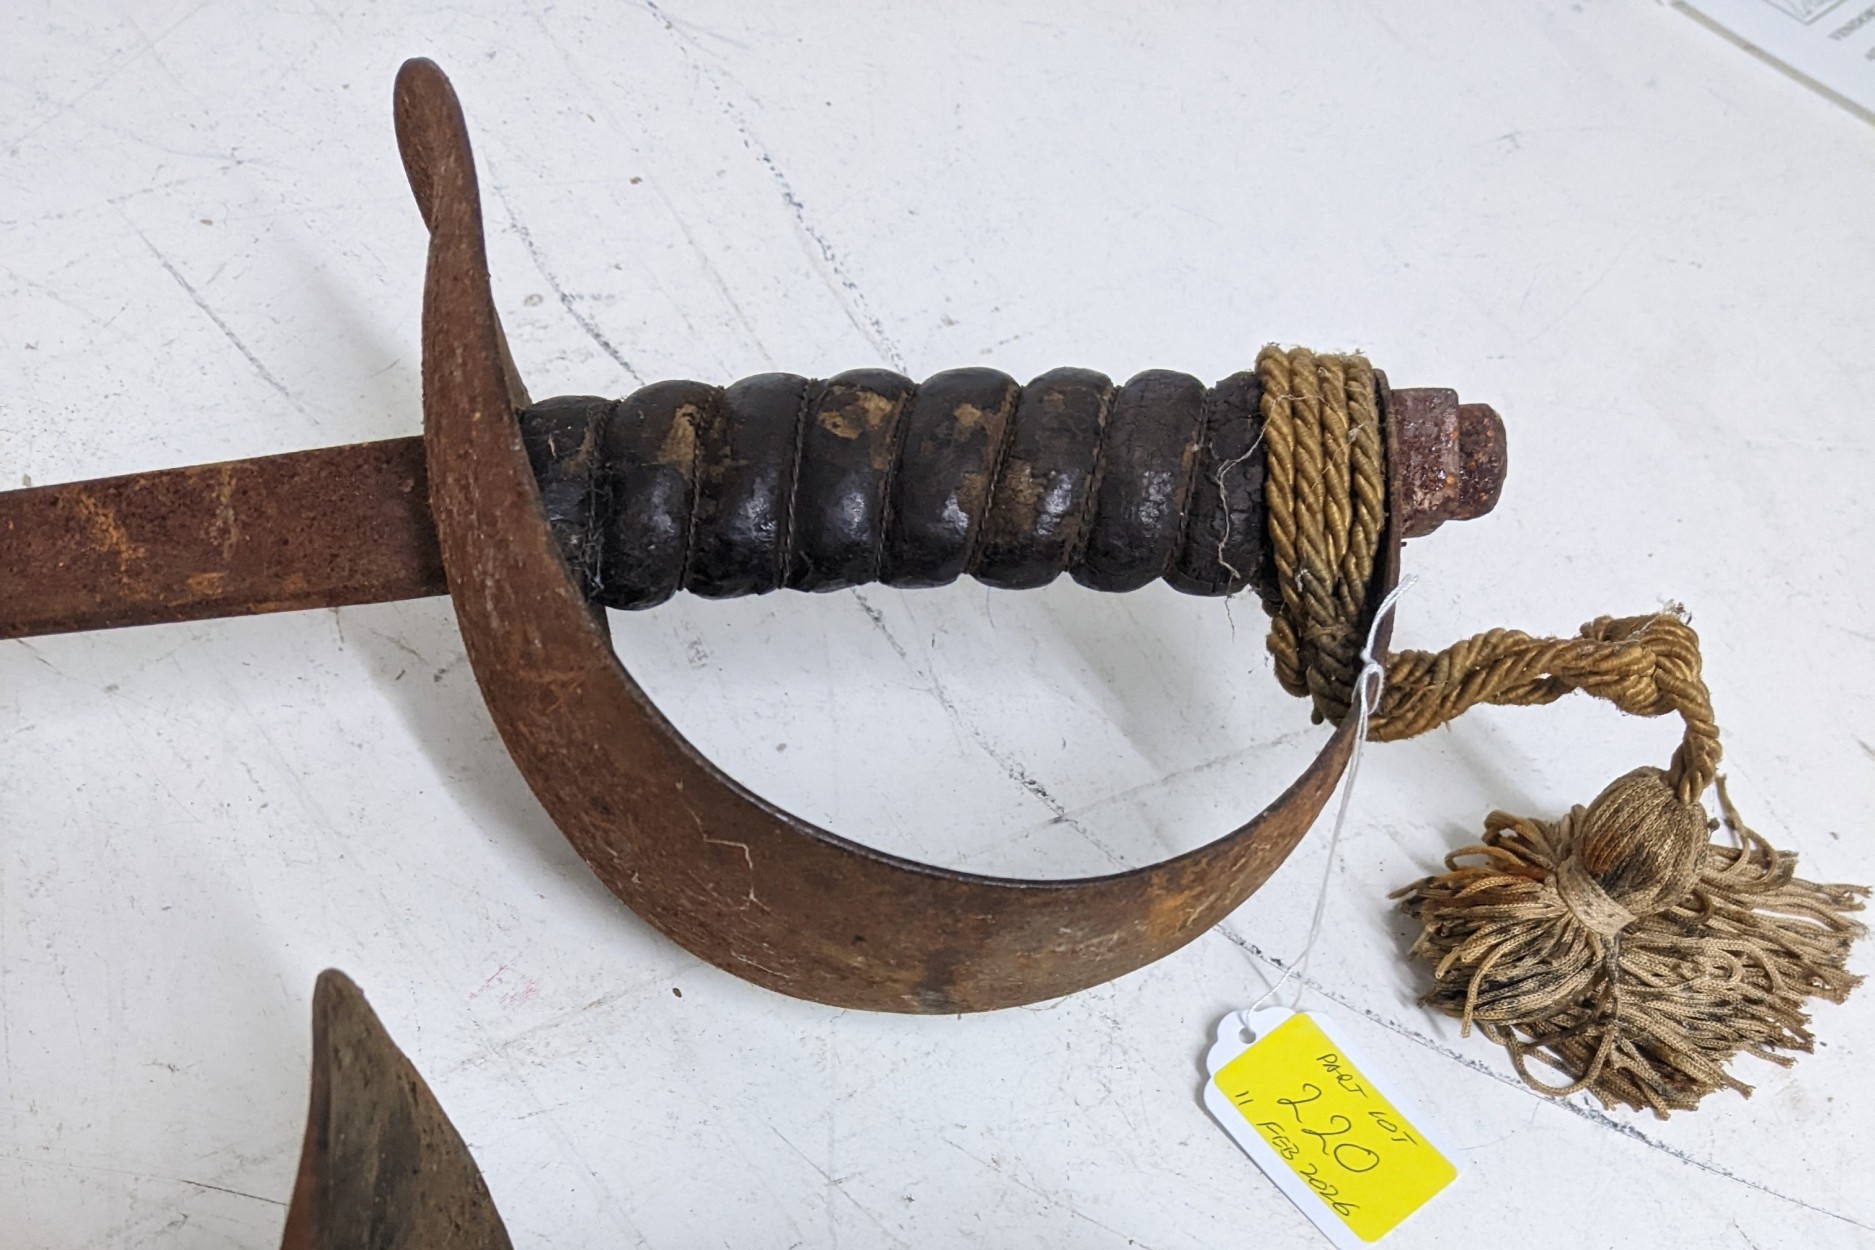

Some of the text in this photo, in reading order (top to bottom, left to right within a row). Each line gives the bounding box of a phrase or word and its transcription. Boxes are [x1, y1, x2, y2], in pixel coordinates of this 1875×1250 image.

[1277, 1083, 1380, 1172] 220
[1316, 1053, 1418, 1146] PART LOT
[1256, 1121, 1300, 1161] FEB
[1299, 1163, 1360, 1216] 2026
